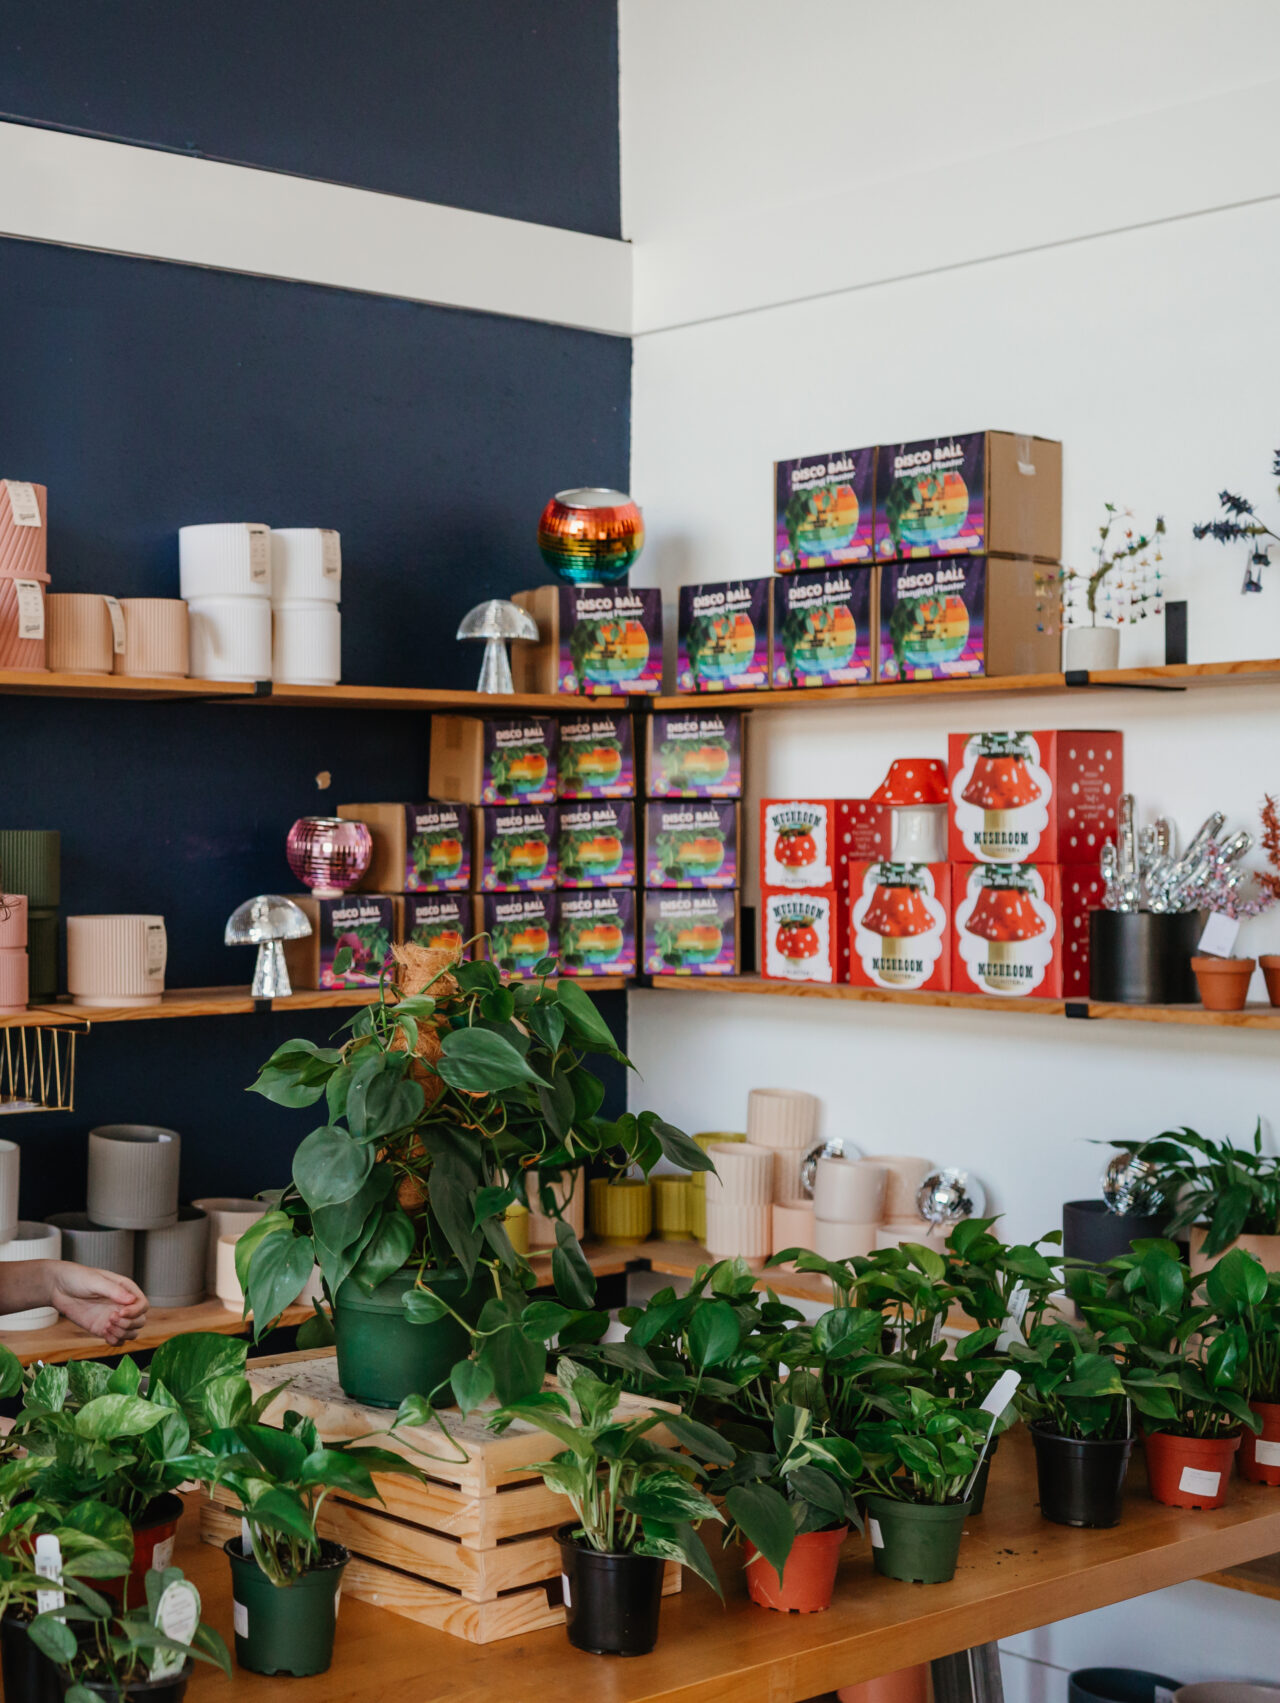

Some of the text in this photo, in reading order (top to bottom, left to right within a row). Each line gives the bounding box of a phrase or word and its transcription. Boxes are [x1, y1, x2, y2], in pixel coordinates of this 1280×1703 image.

[894, 444, 963, 469] DISCO BALL
[792, 458, 854, 482] DISCO BALL
[894, 458, 964, 479] Hanging Planter
[897, 568, 965, 589] DISCO BALL
[789, 579, 851, 600] DISCO BALL
[897, 582, 966, 599] Hanging Planter
[576, 596, 643, 611] DISCO BALL
[694, 588, 751, 608] DISCO BALL
[496, 727, 544, 740] DISCO BALL
[561, 721, 616, 735] DISCO BALL
[667, 720, 725, 733] DISCO BALL
[416, 812, 458, 825] DISCO BALL
[496, 814, 544, 827] DISCO BALL
[560, 809, 617, 824] DISCO BALL
[662, 811, 719, 823] DISCO BALL
[772, 811, 822, 827] MUSHROOM
[974, 832, 1028, 845] MUSHROOM
[416, 903, 459, 917] DISCO BALL
[496, 901, 545, 915] DISCO BALL
[561, 898, 618, 911] DISCO BALL
[660, 898, 718, 911] DISCO BALL
[773, 902, 824, 920] MUSHROOM
[332, 906, 380, 920] DISCO BALL
[873, 958, 923, 972] MUSHROOM
[978, 963, 1033, 979] MUSHROOM
